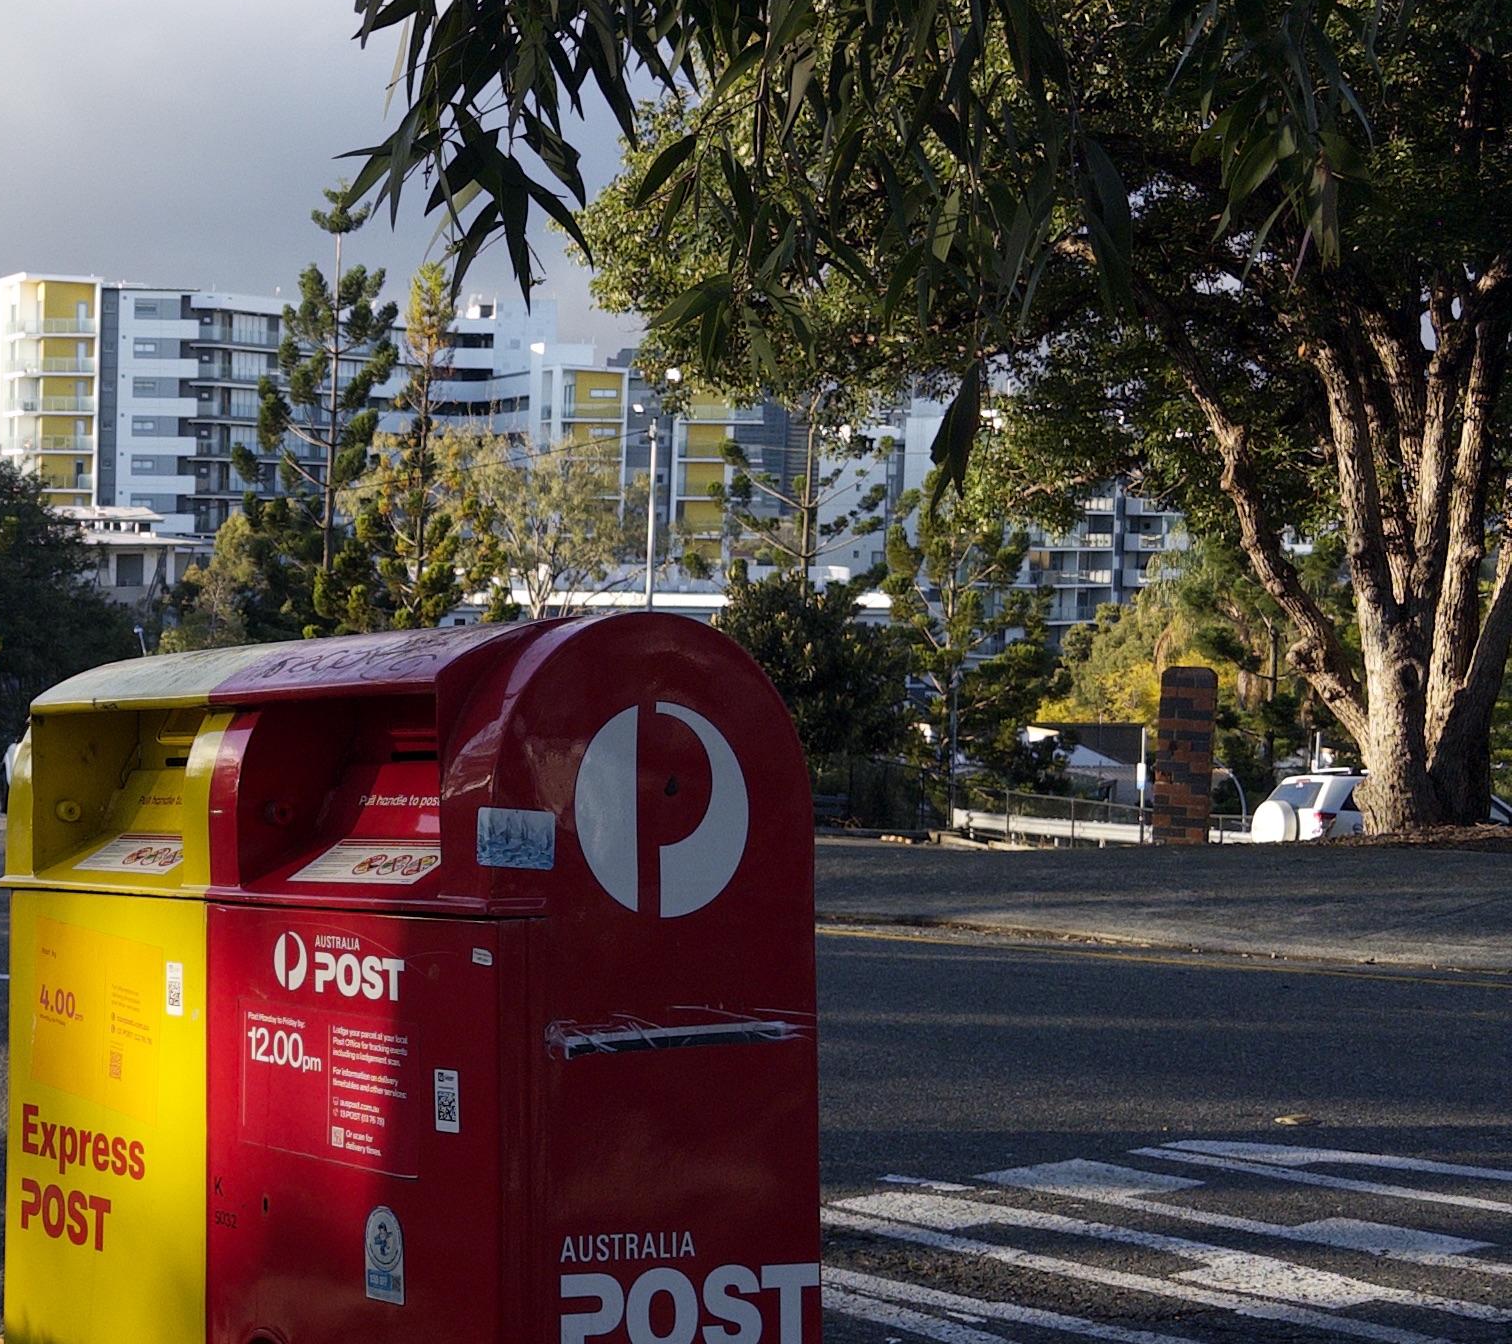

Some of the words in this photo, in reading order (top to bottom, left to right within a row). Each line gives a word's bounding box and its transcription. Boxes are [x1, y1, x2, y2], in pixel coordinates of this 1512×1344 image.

[376, 794, 408, 807] handle
[408, 794, 419, 807] to
[314, 934, 361, 952] AUSTRALIA
[314, 951, 406, 1002] POST
[22, 1103, 146, 1181] Express
[214, 1176, 224, 1197] K
[21, 1177, 112, 1253] POST
[559, 1231, 696, 1264] AUSTRALIA
